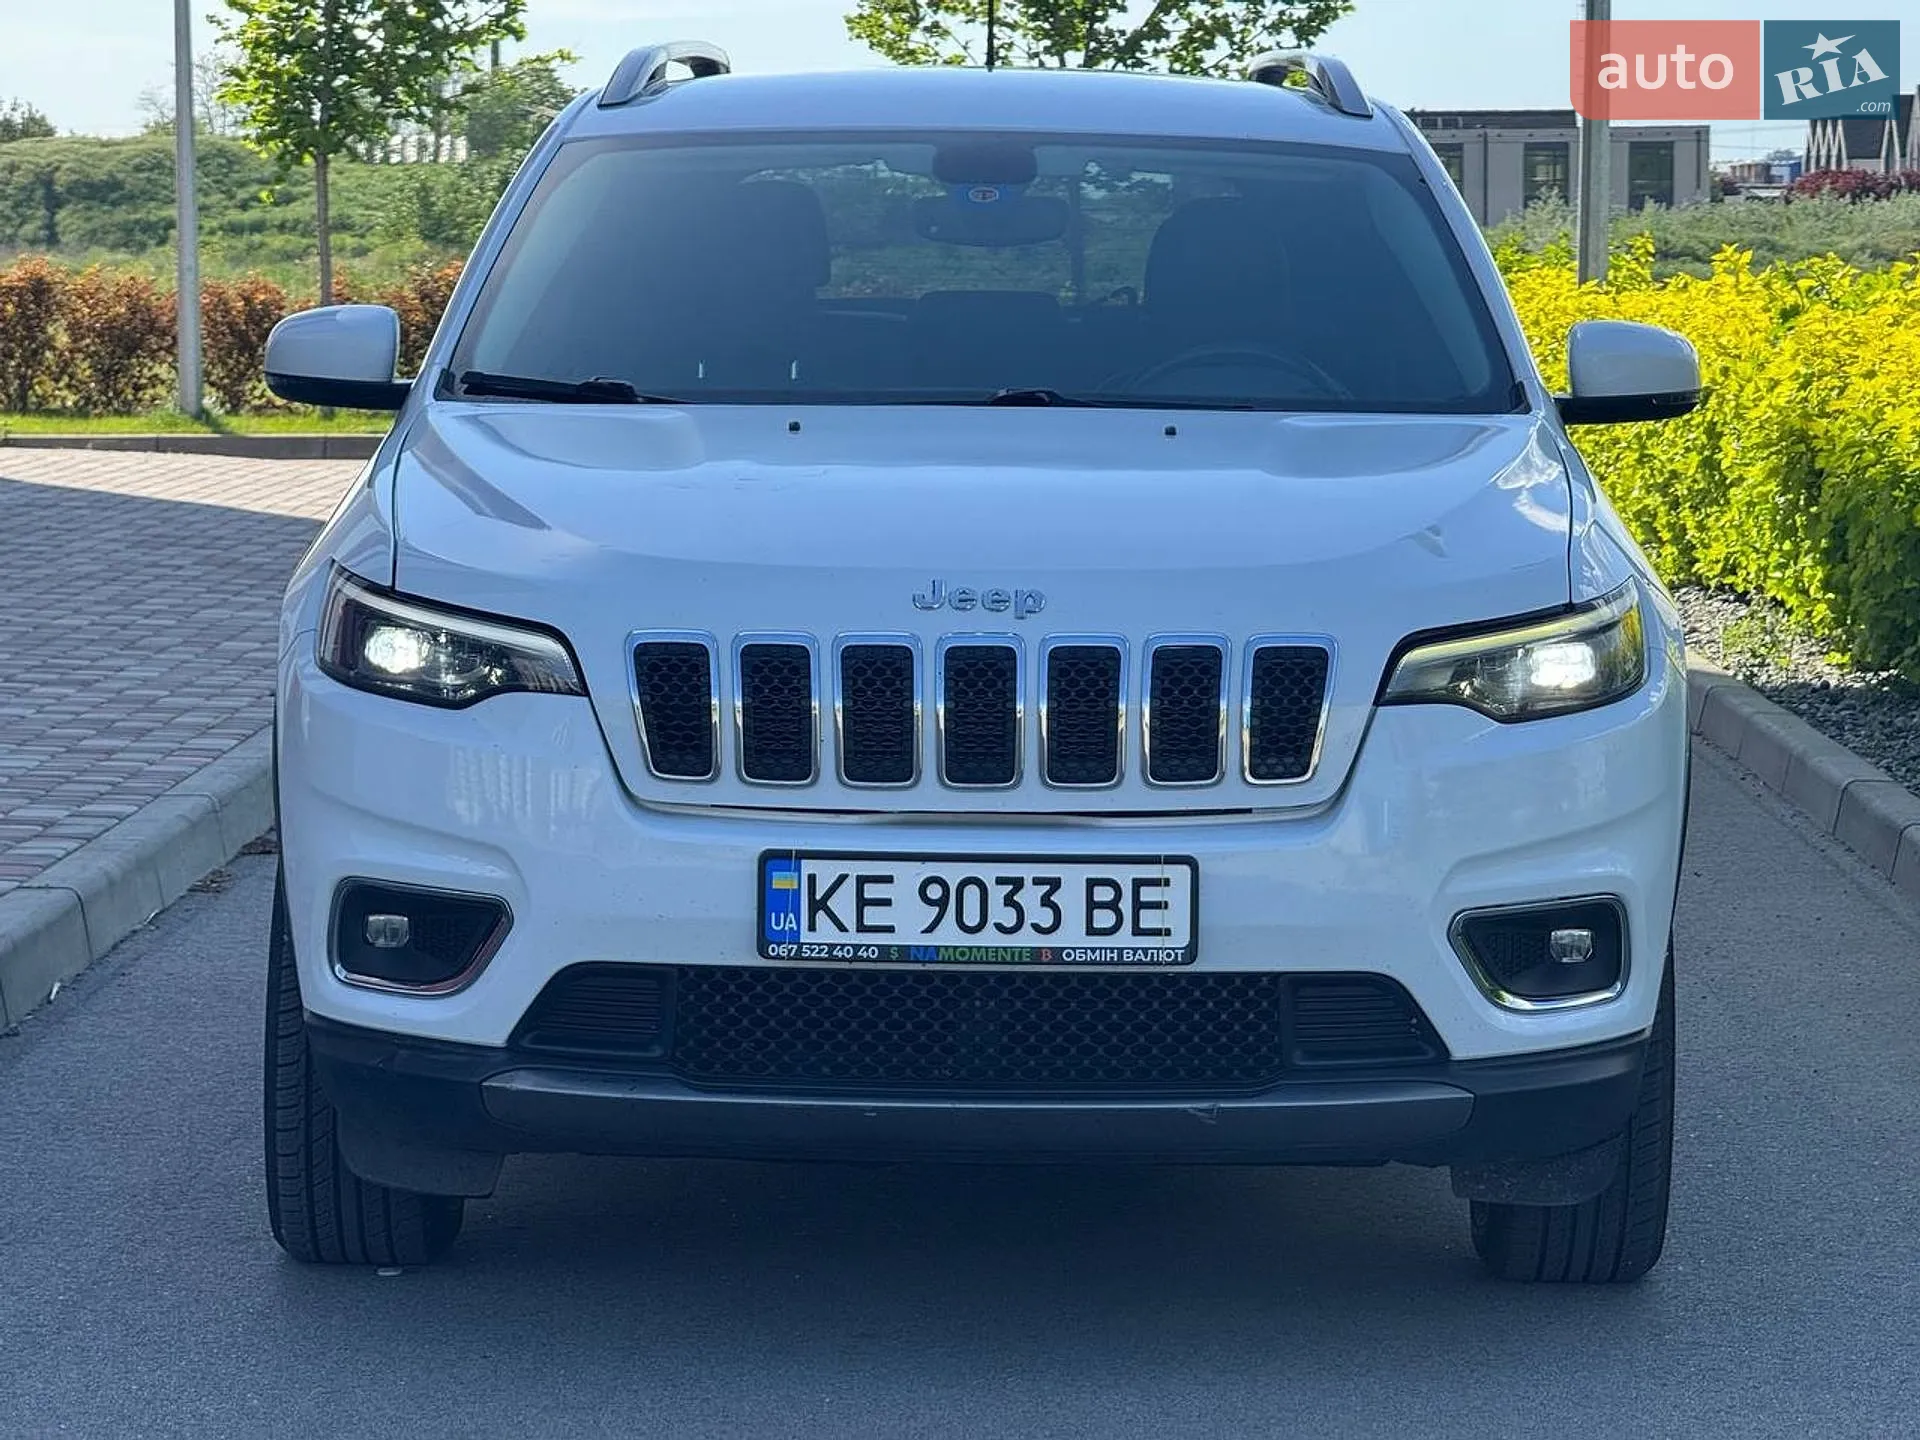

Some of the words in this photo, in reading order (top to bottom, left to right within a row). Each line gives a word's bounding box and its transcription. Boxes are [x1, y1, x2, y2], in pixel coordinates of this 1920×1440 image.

[912, 578, 1046, 620] Jeep
[807, 873, 895, 933] KE
[918, 876, 1062, 934] 9033
[1085, 877, 1171, 936] BE
[771, 912, 797, 931] UA
[768, 944, 797, 956] 067
[801, 945, 829, 957] 522
[832, 945, 854, 958] 40
[857, 946, 879, 959] 40
[911, 947, 1031, 961] NAMOMENTE
[1062, 949, 1118, 961] ОБМІН
[1123, 949, 1185, 961] ВАЛЮТ
